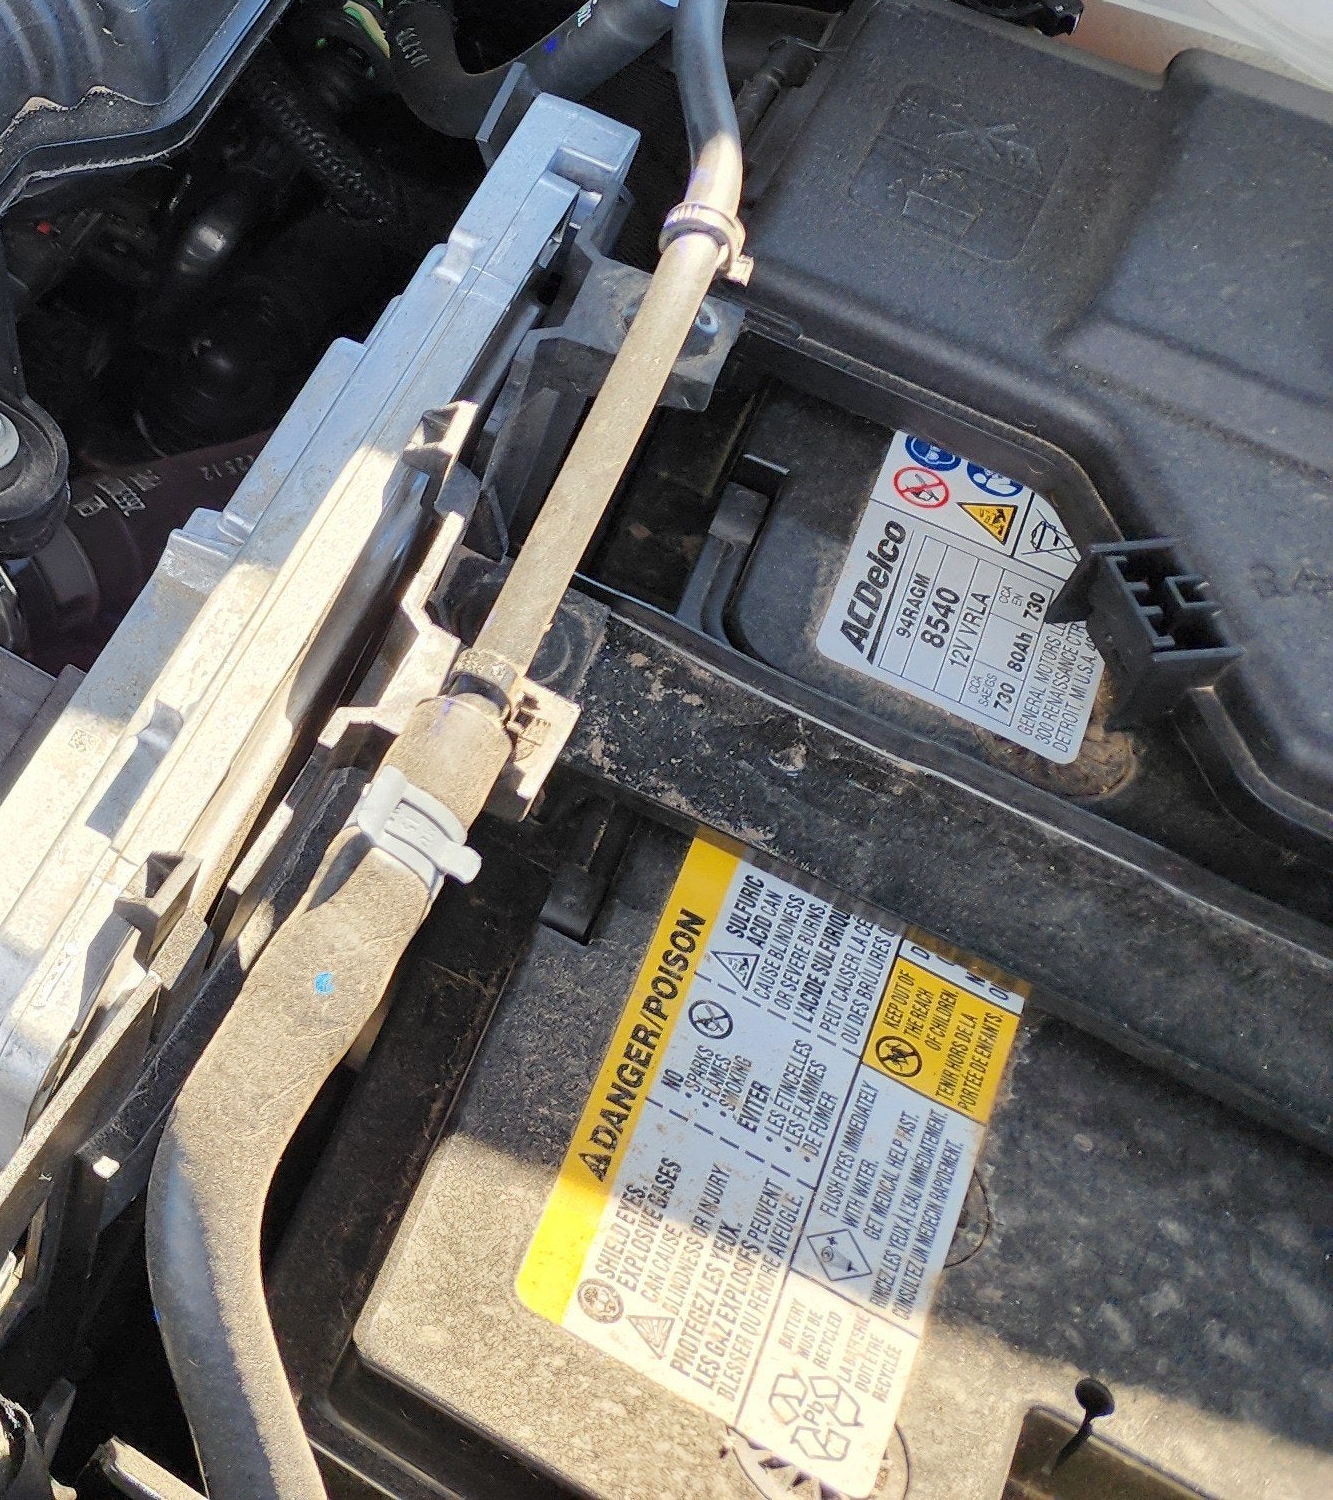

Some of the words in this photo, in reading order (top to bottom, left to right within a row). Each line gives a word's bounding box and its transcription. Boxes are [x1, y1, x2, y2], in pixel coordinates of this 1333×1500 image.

[838, 518, 905, 651] ACDelco
[999, 586, 1012, 603] CCA
[1012, 593, 1023, 606] EN
[897, 574, 929, 637] 94RAGM
[921, 587, 959, 648] 8540
[960, 591, 990, 635] VRLA
[1025, 592, 1045, 620] 730
[949, 638, 972, 667] 12V
[1008, 633, 1032, 672] 80Ah
[969, 676, 981, 693] CCA
[978, 673, 997, 707] SAE/GS
[994, 683, 1015, 711] 730
[1018, 686, 1046, 735] GENERAL
[1034, 636, 1061, 683] MOTORS
[1043, 646, 1078, 721] RENAISSANCE
[1036, 722, 1054, 744] 300
[1053, 701, 1081, 752] DETROIT,
[1069, 685, 1086, 701] MI
[726, 876, 764, 938] SULFURIC
[747, 915, 772, 949] ACID
[761, 890, 782, 916] CAN
[798, 901, 826, 945] BURNS.
[754, 959, 781, 999] CAUSE
[769, 895, 804, 960] BLINDNESS
[848, 936, 867, 954] LA
[781, 944, 810, 991] SEVERE
[795, 974, 826, 1022] L'ACIDE
[811, 907, 850, 976] SULFURIQU
[831, 953, 861, 1002] CAUSER
[855, 936, 891, 1000] BRÛLURES
[898, 969, 915, 986] OF
[774, 990, 793, 1010] OR
[847, 1000, 869, 1025] DES
[891, 982, 910, 1005] OUT
[910, 988, 933, 1020] REACH
[592, 909, 703, 1151] DANGER/POISON
[820, 1001, 843, 1034] PEUT
[883, 1003, 903, 1029] KEEP
[904, 1018, 923, 1039] THE
[930, 989, 958, 1037] CHILDREN.
[959, 1013, 977, 1029] LA
[841, 1024, 860, 1044] OU
[925, 1034, 941, 1051] OF
[955, 1026, 973, 1043] DE
[974, 1011, 1002, 1059] ENFANTS.
[685, 1045, 713, 1092] SPARKS
[773, 1039, 812, 1111] ÉTINCELLES
[946, 1042, 968, 1071] HORS
[970, 1056, 988, 1073] DE
[662, 1069, 683, 1091] NO
[702, 1054, 731, 1102] FLAMES
[719, 1056, 751, 1111] SMOKING
[793, 1060, 827, 1120] FLAMMES
[936, 1070, 957, 1100] TENIR
[957, 1070, 983, 1111] PORTÉE
[765, 1110, 786, 1136] LES
[783, 1120, 805, 1146] LES
[809, 1092, 837, 1137] FUMER
[843, 1082, 877, 1152] IMMEDIATELY
[897, 1111, 918, 1141] FAST.
[802, 1135, 822, 1156] DE
[887, 1139, 907, 1169] HELP
[907, 1107, 946, 1187] IMMÉDIATEMENT.
[833, 1151, 854, 1180] EYES
[852, 1158, 878, 1198] WATER.
[930, 1140, 962, 1202] RAPIDEMENT.
[748, 1179, 782, 1242] PEUVENT
[820, 1180, 844, 1217] FLUSH
[842, 1197, 863, 1228] WITH
[871, 1170, 899, 1218] MEDICAL
[901, 1189, 921, 1216] L'EAU
[595, 1223, 630, 1279] SHIELD
[616, 1180, 647, 1223] EYES.
[618, 1207, 663, 1291] EXPLOSIVE
[648, 1158, 681, 1208] GASES
[712, 1217, 742, 1262] YEUX.
[768, 1191, 802, 1258] AVEUGLE.
[863, 1216, 883, 1240] GET
[888, 1223, 909, 1251] YEUX
[913, 1199, 943, 1247] MÉDECIN
[652, 1224, 682, 1272] CAUSE
[662, 1238, 703, 1315] BLINDNESS
[691, 1216, 710, 1238] OR
[883, 1250, 901, 1272] LES
[911, 1245, 928, 1263] UN
[641, 1270, 665, 1302] CAN
[701, 1263, 724, 1295] LES
[717, 1240, 760, 1324] EXPLOSIFS
[748, 1255, 780, 1312] RENDRE
[870, 1270, 895, 1307] RINCEZ
[893, 1261, 924, 1320] CONSULTEZ
[667, 1289, 714, 1376] PROTÉGEZ
[705, 1322, 732, 1357] GAZ
[740, 1312, 761, 1335] OU
[778, 1298, 805, 1349] BATTERY
[797, 1326, 815, 1359] MUST
[807, 1309, 823, 1327] BE
[813, 1312, 842, 1369] RECYCLED
[693, 1355, 720, 1389] LES
[717, 1335, 752, 1401] BLESSER
[837, 1366, 853, 1383] LA
[855, 1363, 872, 1393] DOIT
[803, 1400, 825, 1426] Pb
